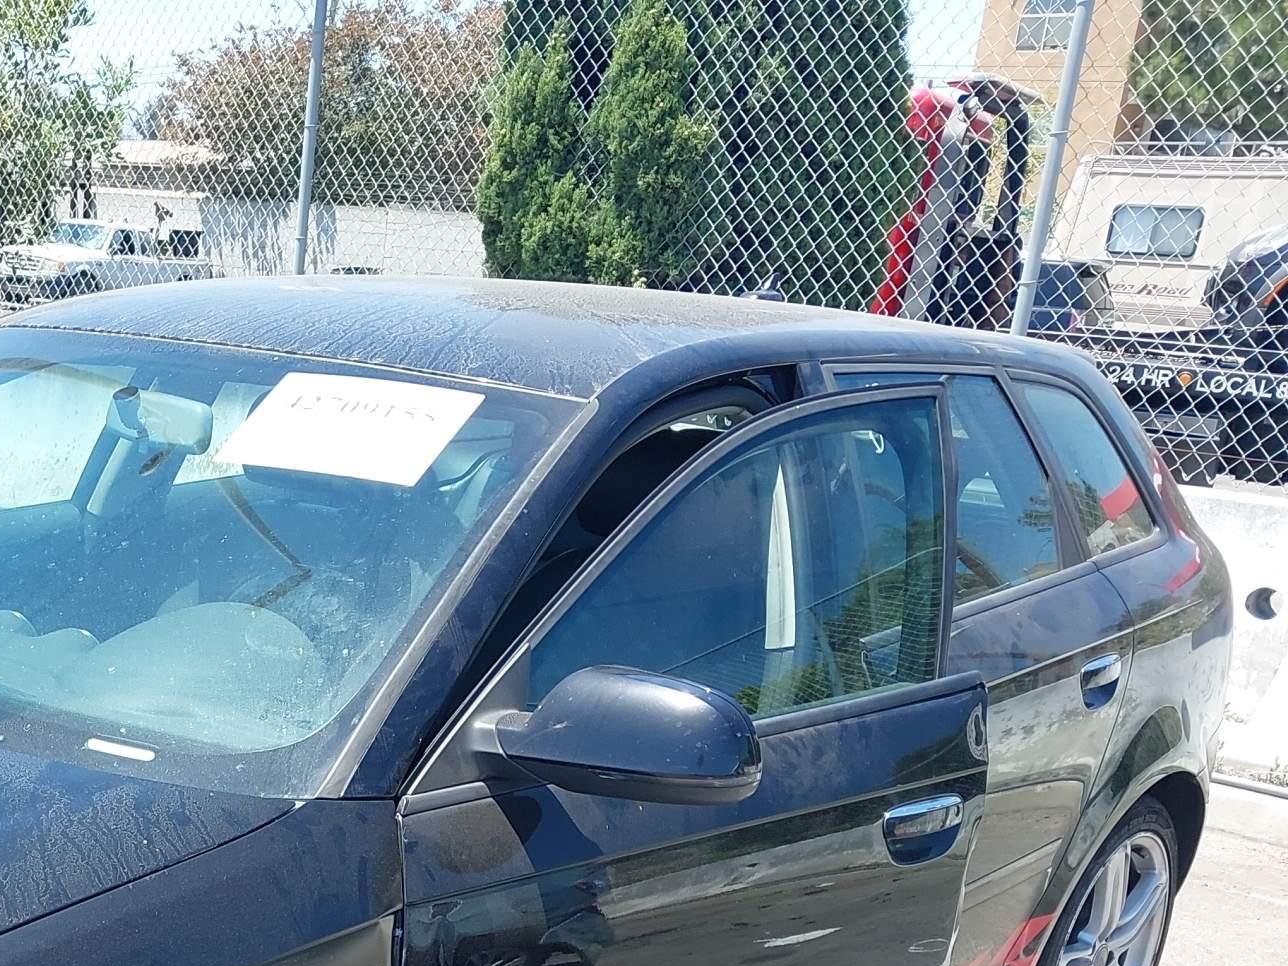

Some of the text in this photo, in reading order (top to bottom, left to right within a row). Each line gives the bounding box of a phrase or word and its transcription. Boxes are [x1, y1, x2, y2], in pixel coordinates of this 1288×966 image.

[1109, 365, 1133, 385] 24
[1141, 368, 1171, 388] HR
[1195, 375, 1272, 398] LOCAL
